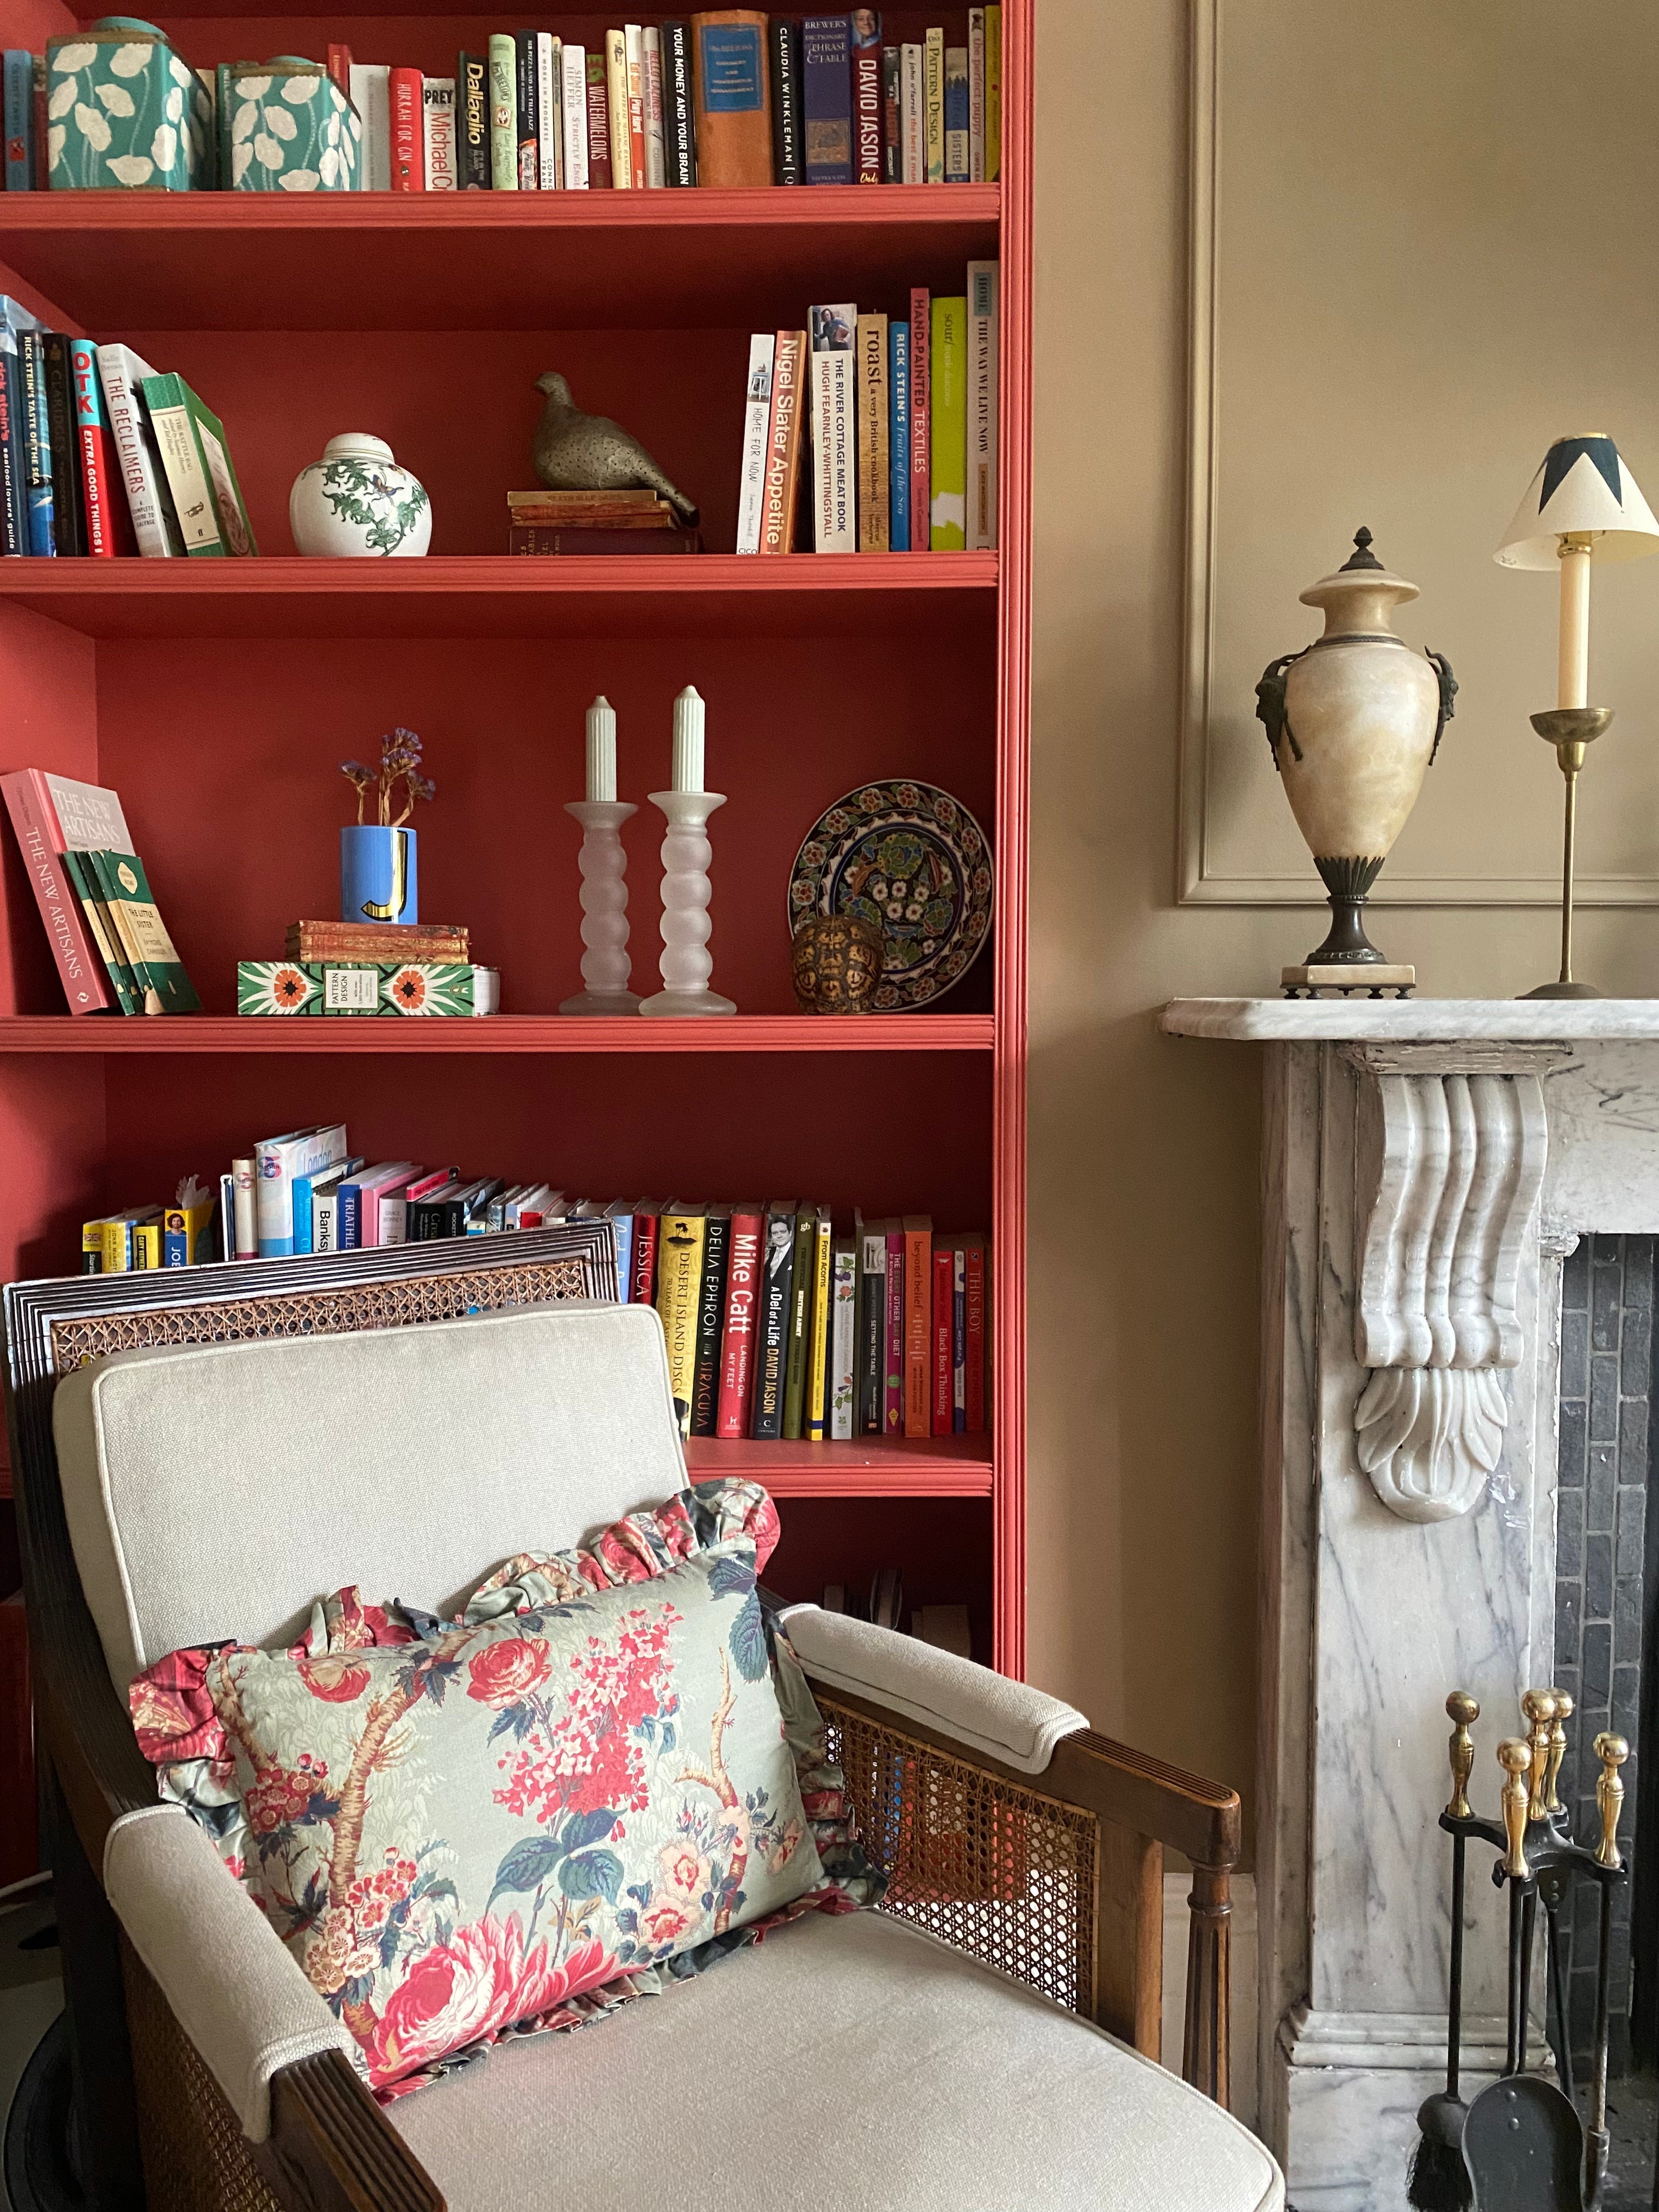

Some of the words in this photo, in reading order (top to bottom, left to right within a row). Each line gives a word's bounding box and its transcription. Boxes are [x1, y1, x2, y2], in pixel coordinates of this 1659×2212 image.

[673, 27, 682, 56] YOUR
[779, 27, 789, 78] CLAUDIA
[974, 38, 983, 50] the
[630, 63, 640, 73] Eat
[650, 50, 659, 77] HELLO
[674, 58, 685, 95] MONEY
[909, 61, 917, 78] john
[929, 47, 940, 97] PATTERN
[973, 55, 983, 99] perfect
[397, 83, 413, 120] HURRAH
[425, 89, 453, 105] PREY
[543, 85, 547, 95] IN
[566, 66, 575, 108] HEFFER
[574, 69, 583, 105] SIMON
[651, 79, 662, 121] LAZINESS
[859, 59, 878, 111] DAVID
[909, 82, 918, 116] o'farrell
[467, 63, 484, 144] Dallaglio
[631, 99, 642, 114] Play
[675, 95, 686, 120] AND
[972, 103, 981, 137] puppy
[397, 124, 413, 142] FOR
[589, 86, 607, 161] WATERMELONS
[633, 116, 644, 133] Hard
[676, 121, 687, 150] YOUR
[782, 82, 793, 162] WINKLEMAN
[929, 101, 941, 145] DESIGN
[398, 146, 413, 161] GIN
[431, 112, 452, 173] Michael
[860, 114, 879, 169] JASON
[952, 133, 962, 172] SISTERS
[678, 152, 689, 185] BRAIN
[978, 276, 988, 312] HOME
[944, 313, 955, 346] sour/
[978, 320, 988, 344] THE
[25, 336, 33, 361] RICK
[775, 339, 798, 389] Nigel
[866, 330, 884, 386] roast
[896, 333, 905, 366] RICK
[914, 298, 925, 408] HAND-PAINTED
[978, 346, 988, 373] WAY
[25, 363, 35, 398] STEIN'S
[821, 361, 830, 392] HUGH
[834, 358, 843, 376] THE
[107, 376, 126, 403] THE
[835, 382, 844, 413] RIVER
[896, 371, 905, 422] STEIN'S
[978, 374, 988, 394] WE
[28, 400, 37, 428] TASTE
[751, 407, 763, 432] HOME
[774, 394, 795, 453] Slater
[868, 397, 878, 419] very
[978, 396, 988, 424] LIVE
[83, 430, 95, 466] EXTRA
[113, 408, 145, 494] RECLAIMERS
[750, 439, 761, 456] FOR
[836, 416, 845, 466] COTTAGE
[871, 420, 879, 454] British
[913, 410, 926, 473] TEXTILES
[978, 427, 988, 455] NOW
[3, 448, 12, 486] seafood
[32, 467, 41, 485] SEA
[749, 461, 759, 482] NOW
[822, 395, 833, 538] FEARNLEY-WHITTINGSTALL
[837, 469, 845, 494] MEAT
[871, 455, 880, 502] cookbook
[895, 461, 906, 472] of
[87, 467, 98, 501] GOOD
[766, 456, 789, 545] Appetite
[898, 476, 906, 493] the
[5, 488, 15, 521] lovers'
[837, 497, 846, 532] BOOK
[897, 496, 905, 515] Sea
[7, 523, 16, 549] guide
[91, 503, 103, 546] THINGS
[53, 788, 84, 815] THE
[82, 797, 110, 821] NEW
[26, 827, 47, 862] THE
[64, 815, 121, 844] ARTISANS
[36, 863, 60, 901] NEW
[137, 921, 154, 929] SISTER
[138, 910, 154, 918] LITTLE
[48, 905, 83, 979] ARTISANS
[799, 1222, 811, 1232] gb
[171, 1246, 182, 1268] JOE
[708, 1227, 723, 1268] DELIA
[731, 1233, 757, 1283] Mike
[911, 1241, 923, 1278] beyond
[636, 1233, 653, 1296] JESSICA
[676, 1252, 690, 1300] DESERT
[769, 1294, 783, 1310] Del
[913, 1280, 924, 1308] belief
[969, 1271, 981, 1302] THIS
[664, 1310, 671, 1319] OF
[703, 1275, 719, 1336] EPHRON
[728, 1289, 753, 1334] Catt
[769, 1311, 778, 1319] of
[969, 1308, 981, 1334] BOY
[674, 1305, 688, 1352] ISLAND
[767, 1326, 781, 1346] Life
[939, 1328, 947, 1352] Black
[672, 1356, 685, 1393] DISCS
[727, 1352, 736, 1364] MY
[737, 1345, 748, 1383] LANDING
[765, 1347, 780, 1379] DAVID
[938, 1355, 947, 1372] Box
[697, 1361, 713, 1427] SIRACUSA
[725, 1367, 735, 1389] FEET
[737, 1385, 745, 1397] ON
[937, 1374, 947, 1415] Thinking
[763, 1381, 777, 1414] JASON
